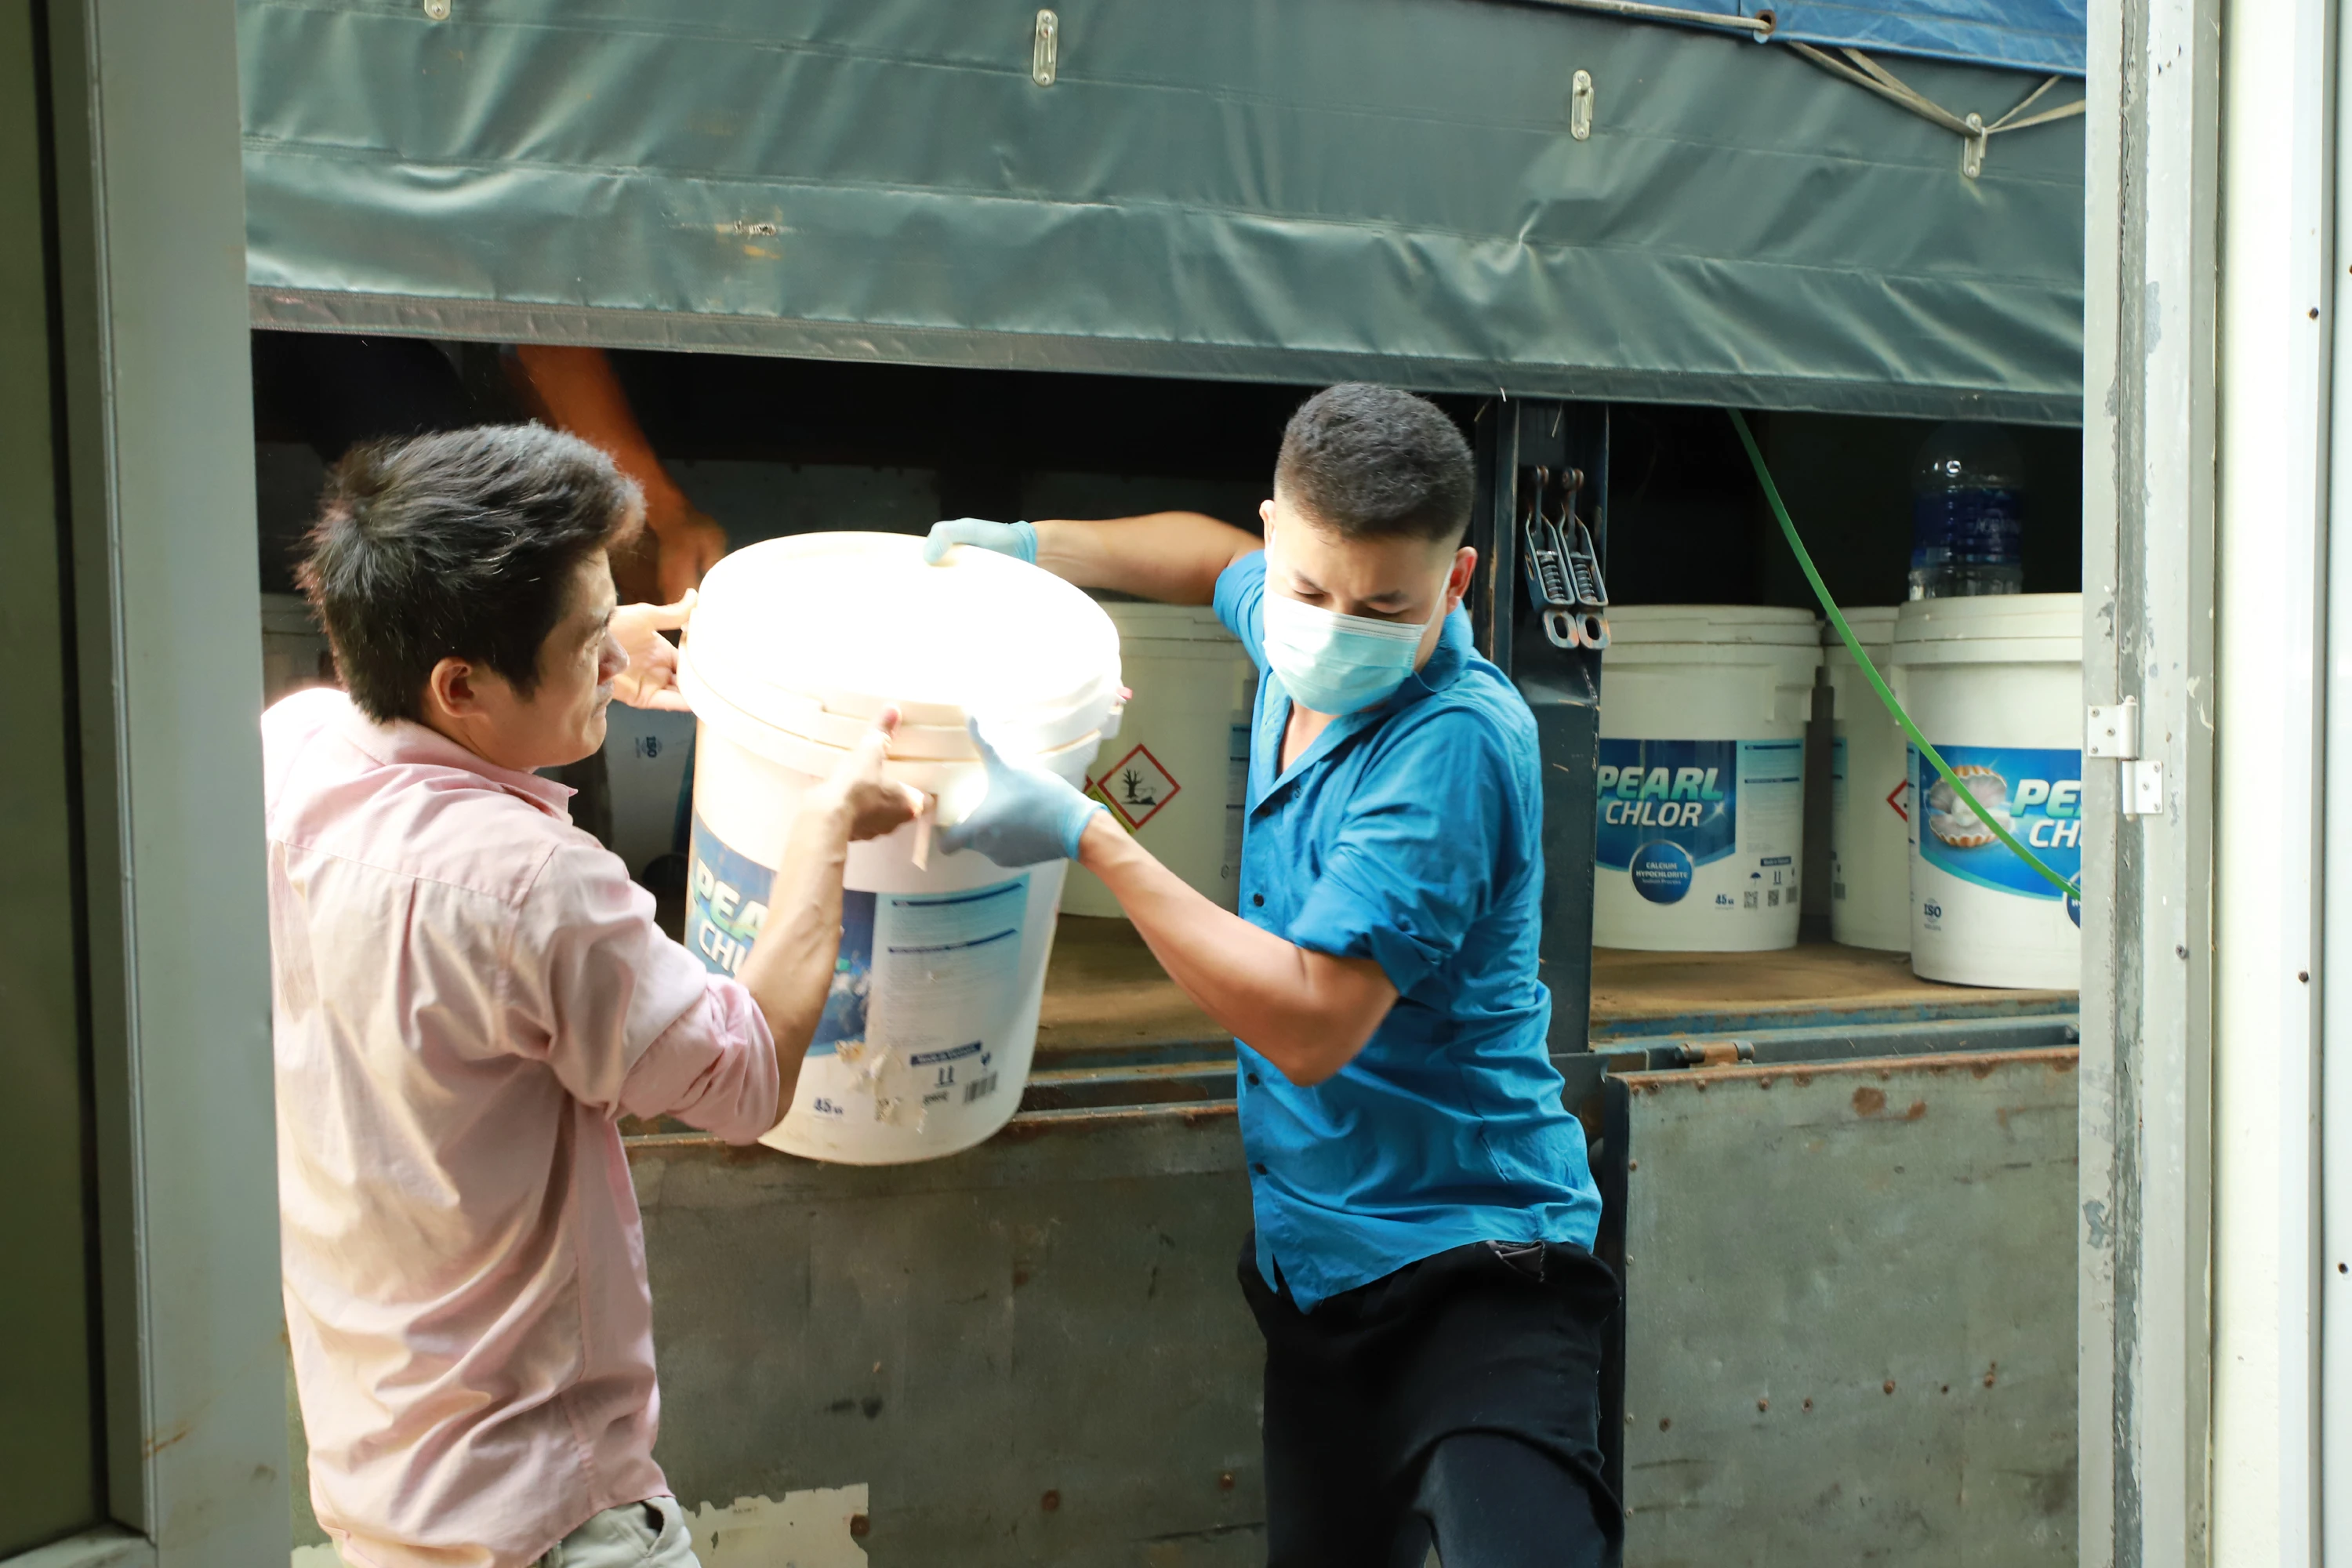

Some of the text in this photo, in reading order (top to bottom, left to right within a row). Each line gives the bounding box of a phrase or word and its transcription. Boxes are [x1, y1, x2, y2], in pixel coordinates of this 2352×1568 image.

[646, 736, 657, 758] ISO
[1597, 765, 1724, 801] PEARL
[2010, 779, 2082, 818] PE
[1606, 800, 1703, 827] CHLOR
[2029, 819, 2082, 848] CH
[1646, 862, 1677, 870] CALCIUM
[693, 858, 769, 942] PEA
[1715, 894, 1727, 905] 45
[1924, 903, 1942, 918] ISO
